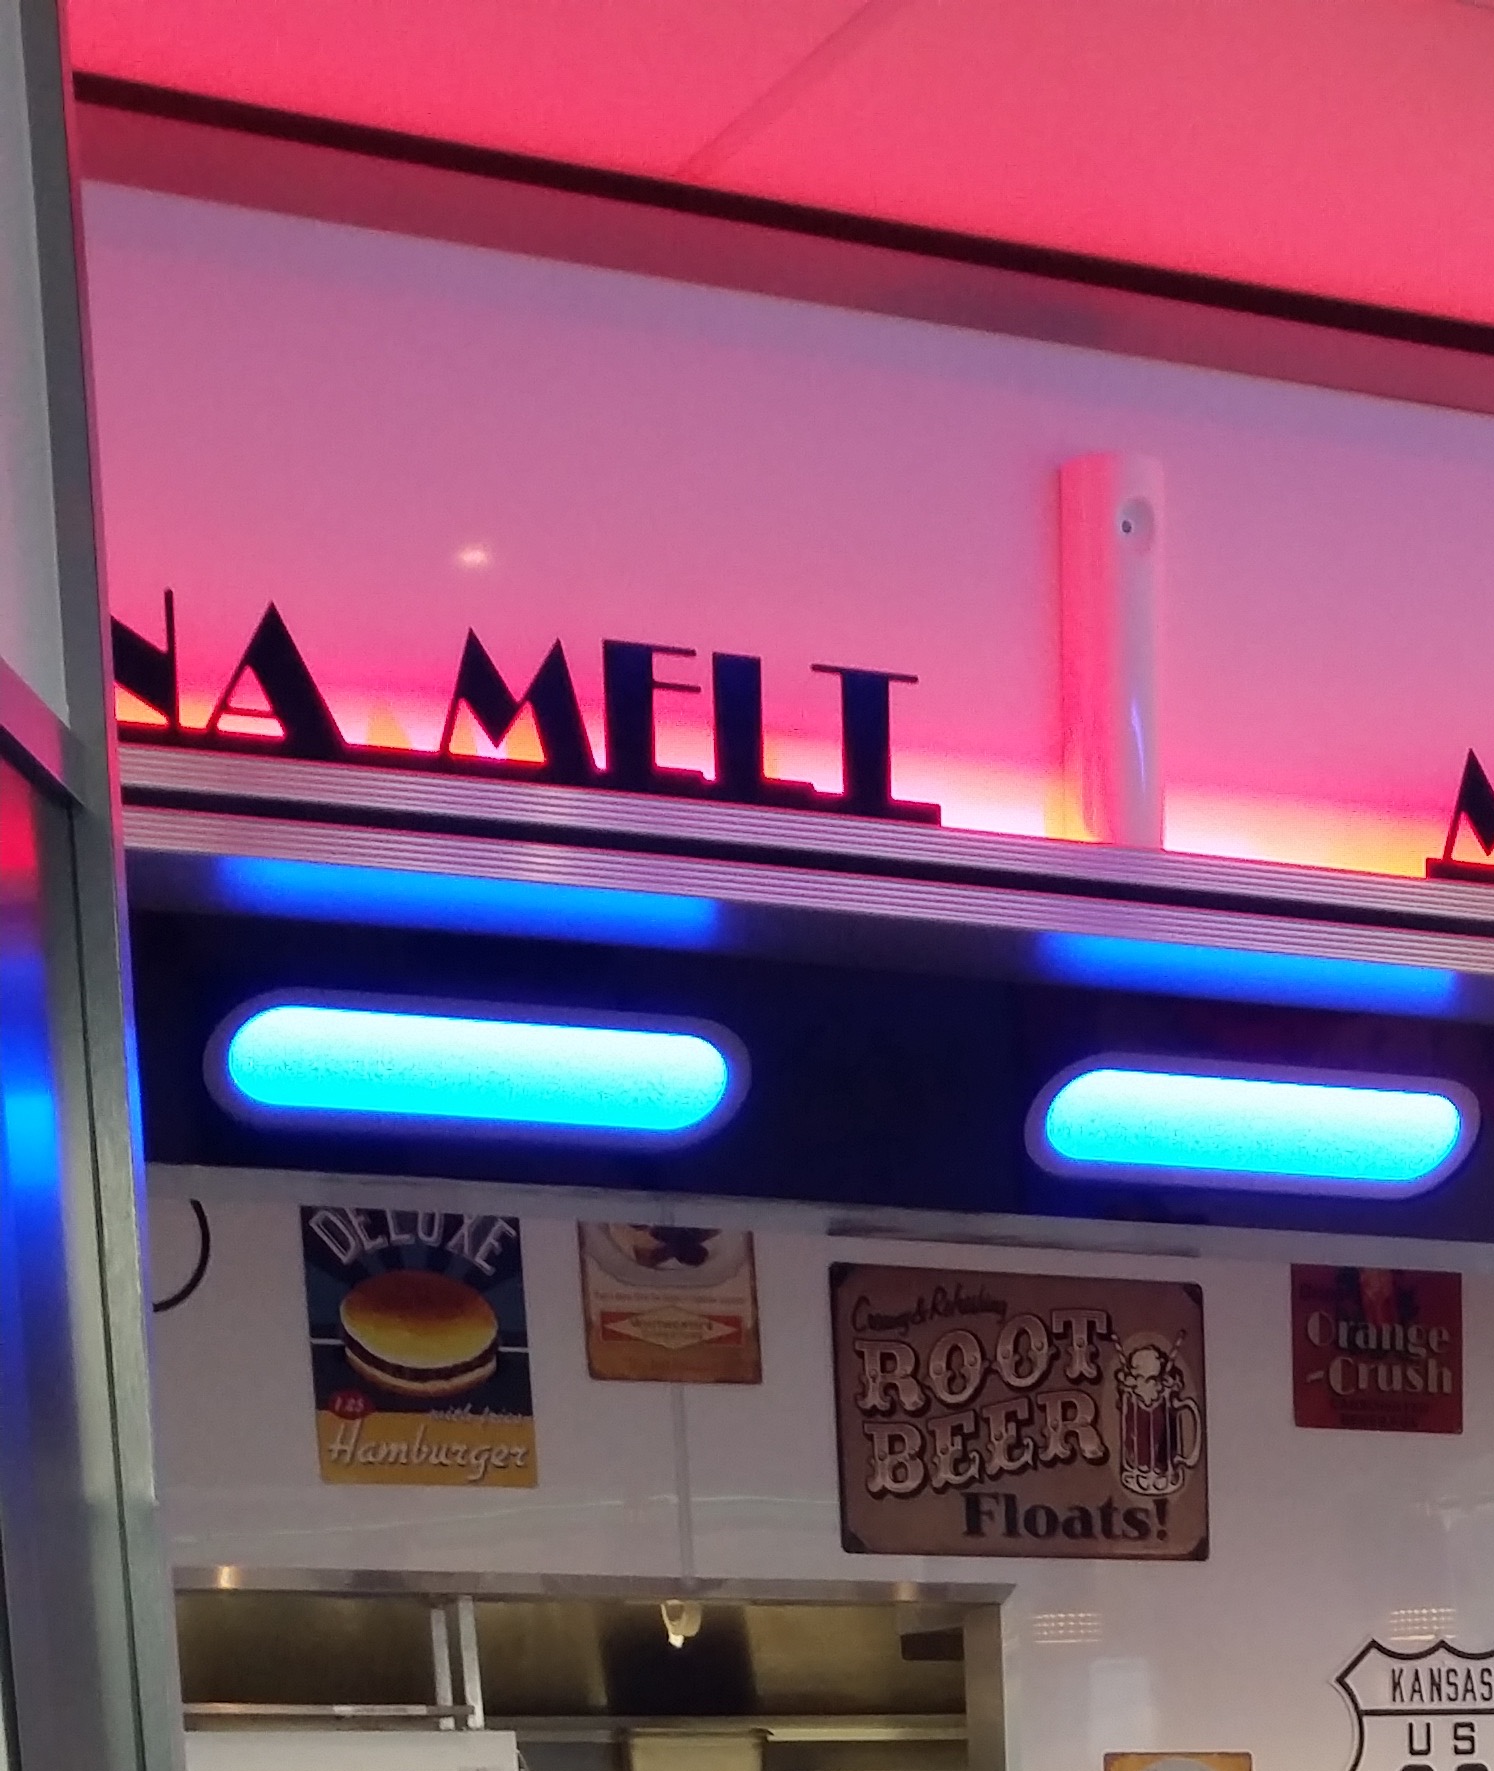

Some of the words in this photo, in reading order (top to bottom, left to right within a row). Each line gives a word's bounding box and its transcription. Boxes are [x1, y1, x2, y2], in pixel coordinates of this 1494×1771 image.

[438, 627, 925, 818] MELT
[308, 1209, 517, 1277] DELUXE
[854, 1307, 1112, 1413] ROOT
[1307, 1310, 1451, 1360] Orange
[329, 1417, 529, 1482] Hamburger
[863, 1387, 1107, 1499] BEER
[962, 1491, 1170, 1541] Floats!
[1390, 1667, 1494, 1704] KANSAS
